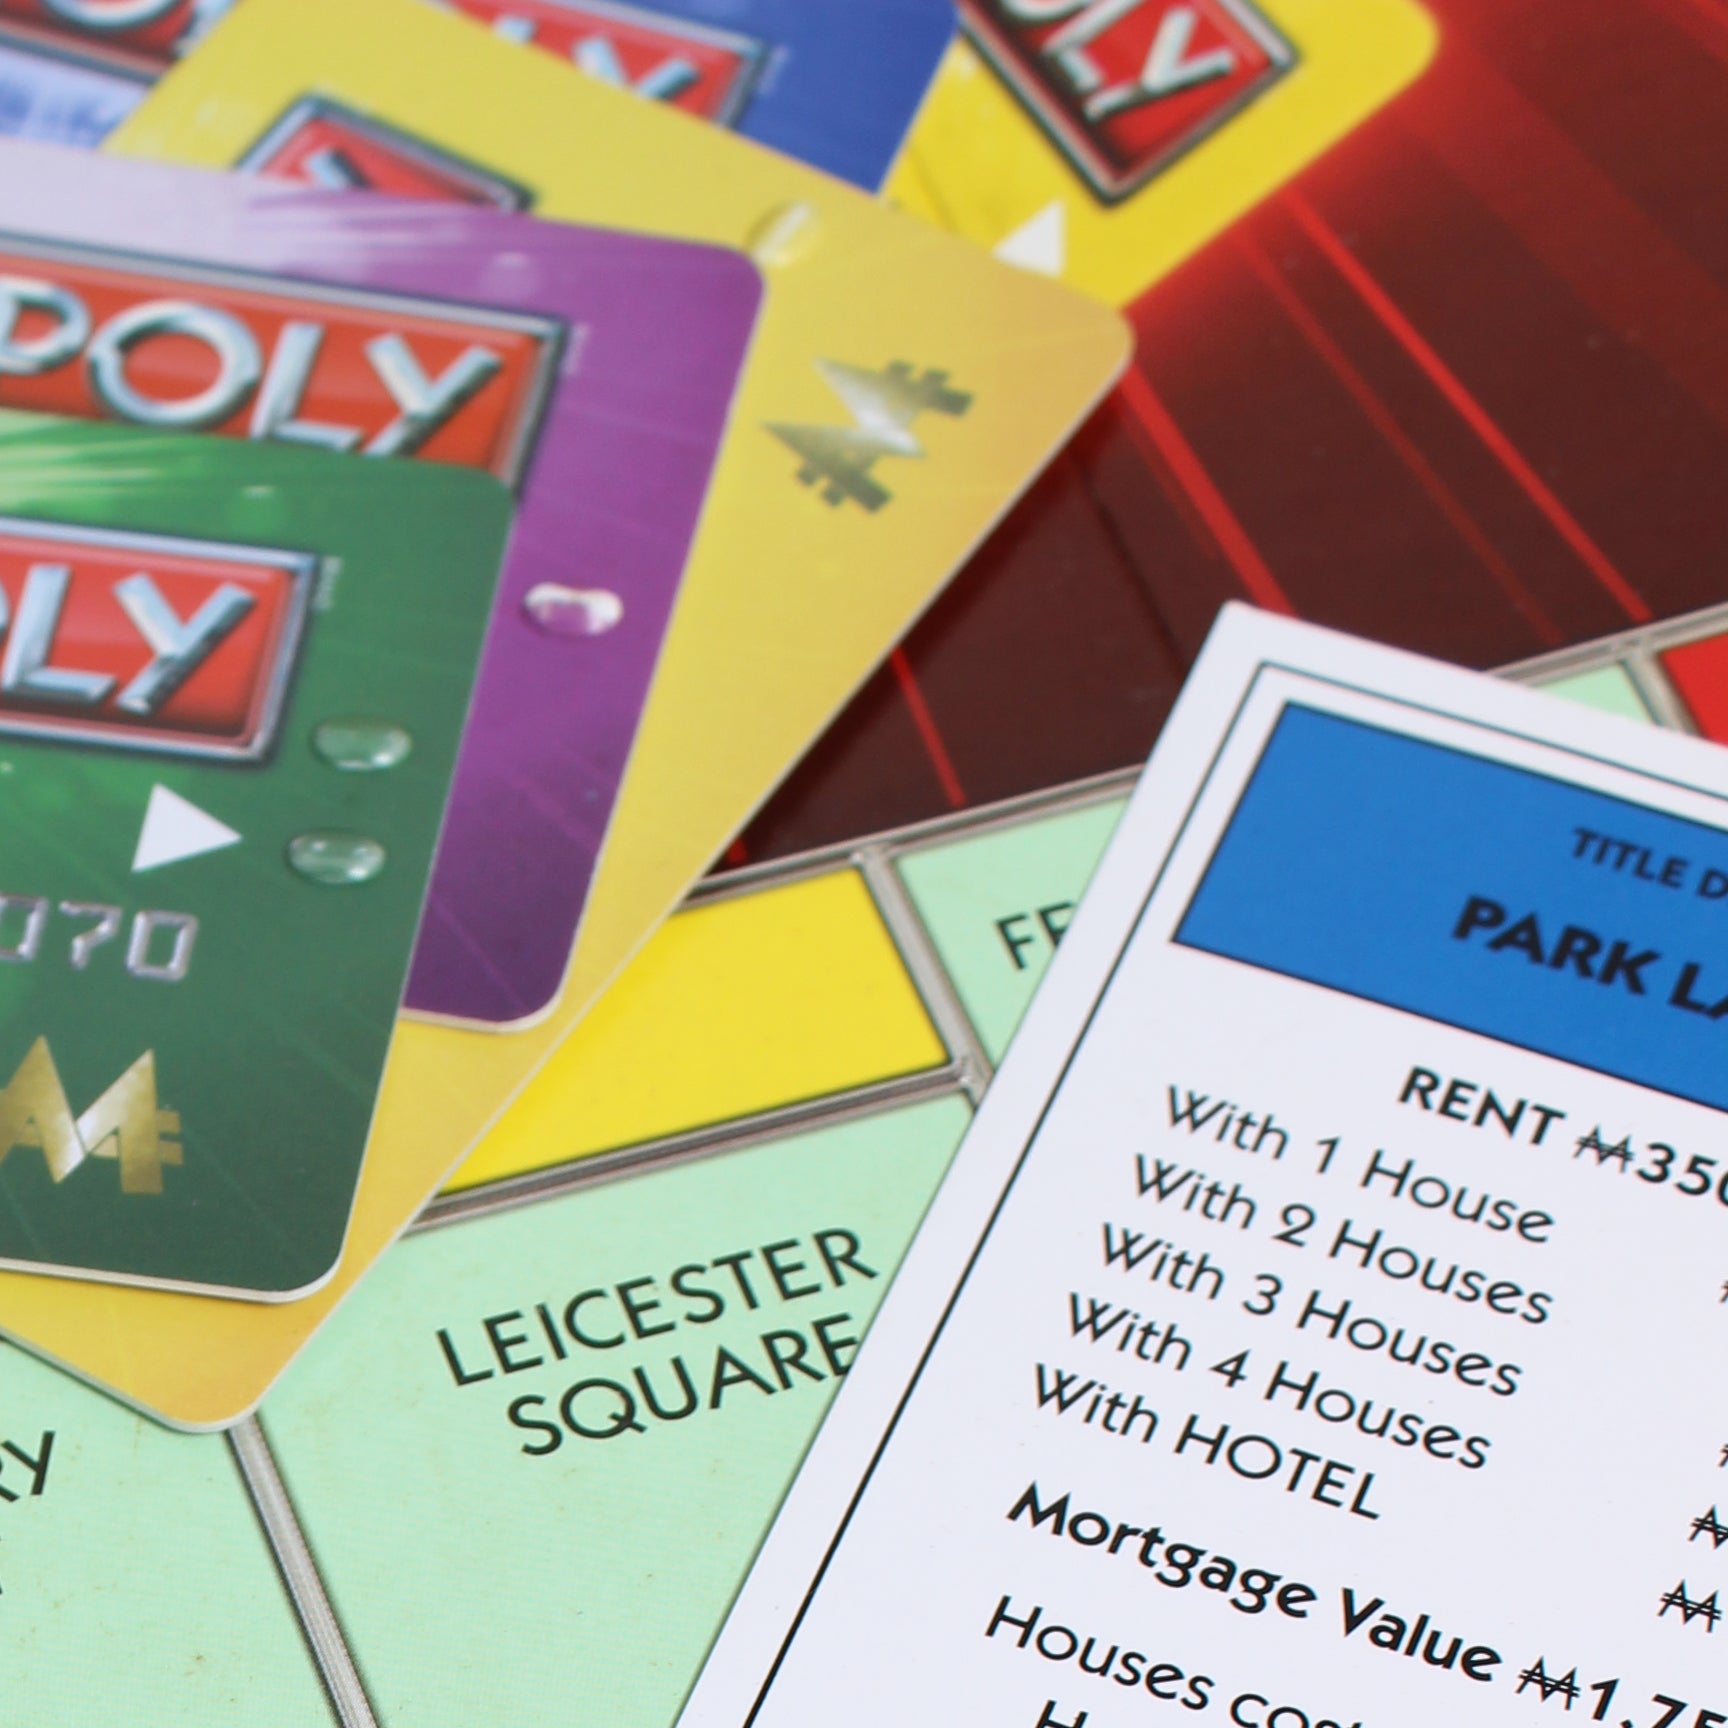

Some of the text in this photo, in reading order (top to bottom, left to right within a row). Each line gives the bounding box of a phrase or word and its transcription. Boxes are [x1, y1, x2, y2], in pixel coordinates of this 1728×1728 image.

[1572, 827, 1690, 889] TITLE
[1452, 894, 1662, 998] PARK
[1166, 1085, 1555, 1243] With 1 House
[1399, 1067, 1566, 1146] RENT
[435, 1227, 879, 1387] LEICESTER
[1101, 1222, 1524, 1397] With 3 Houses
[1133, 1153, 1553, 1325] With 2 Houses
[507, 1311, 862, 1456] SQUARE
[1034, 1362, 1382, 1521] With HOTEL
[1069, 1291, 1492, 1470] With 4 Houses
[984, 1595, 1215, 1710] Houses
[1007, 1481, 1318, 1618] Mortgage
[1341, 1587, 1503, 1681] Value
